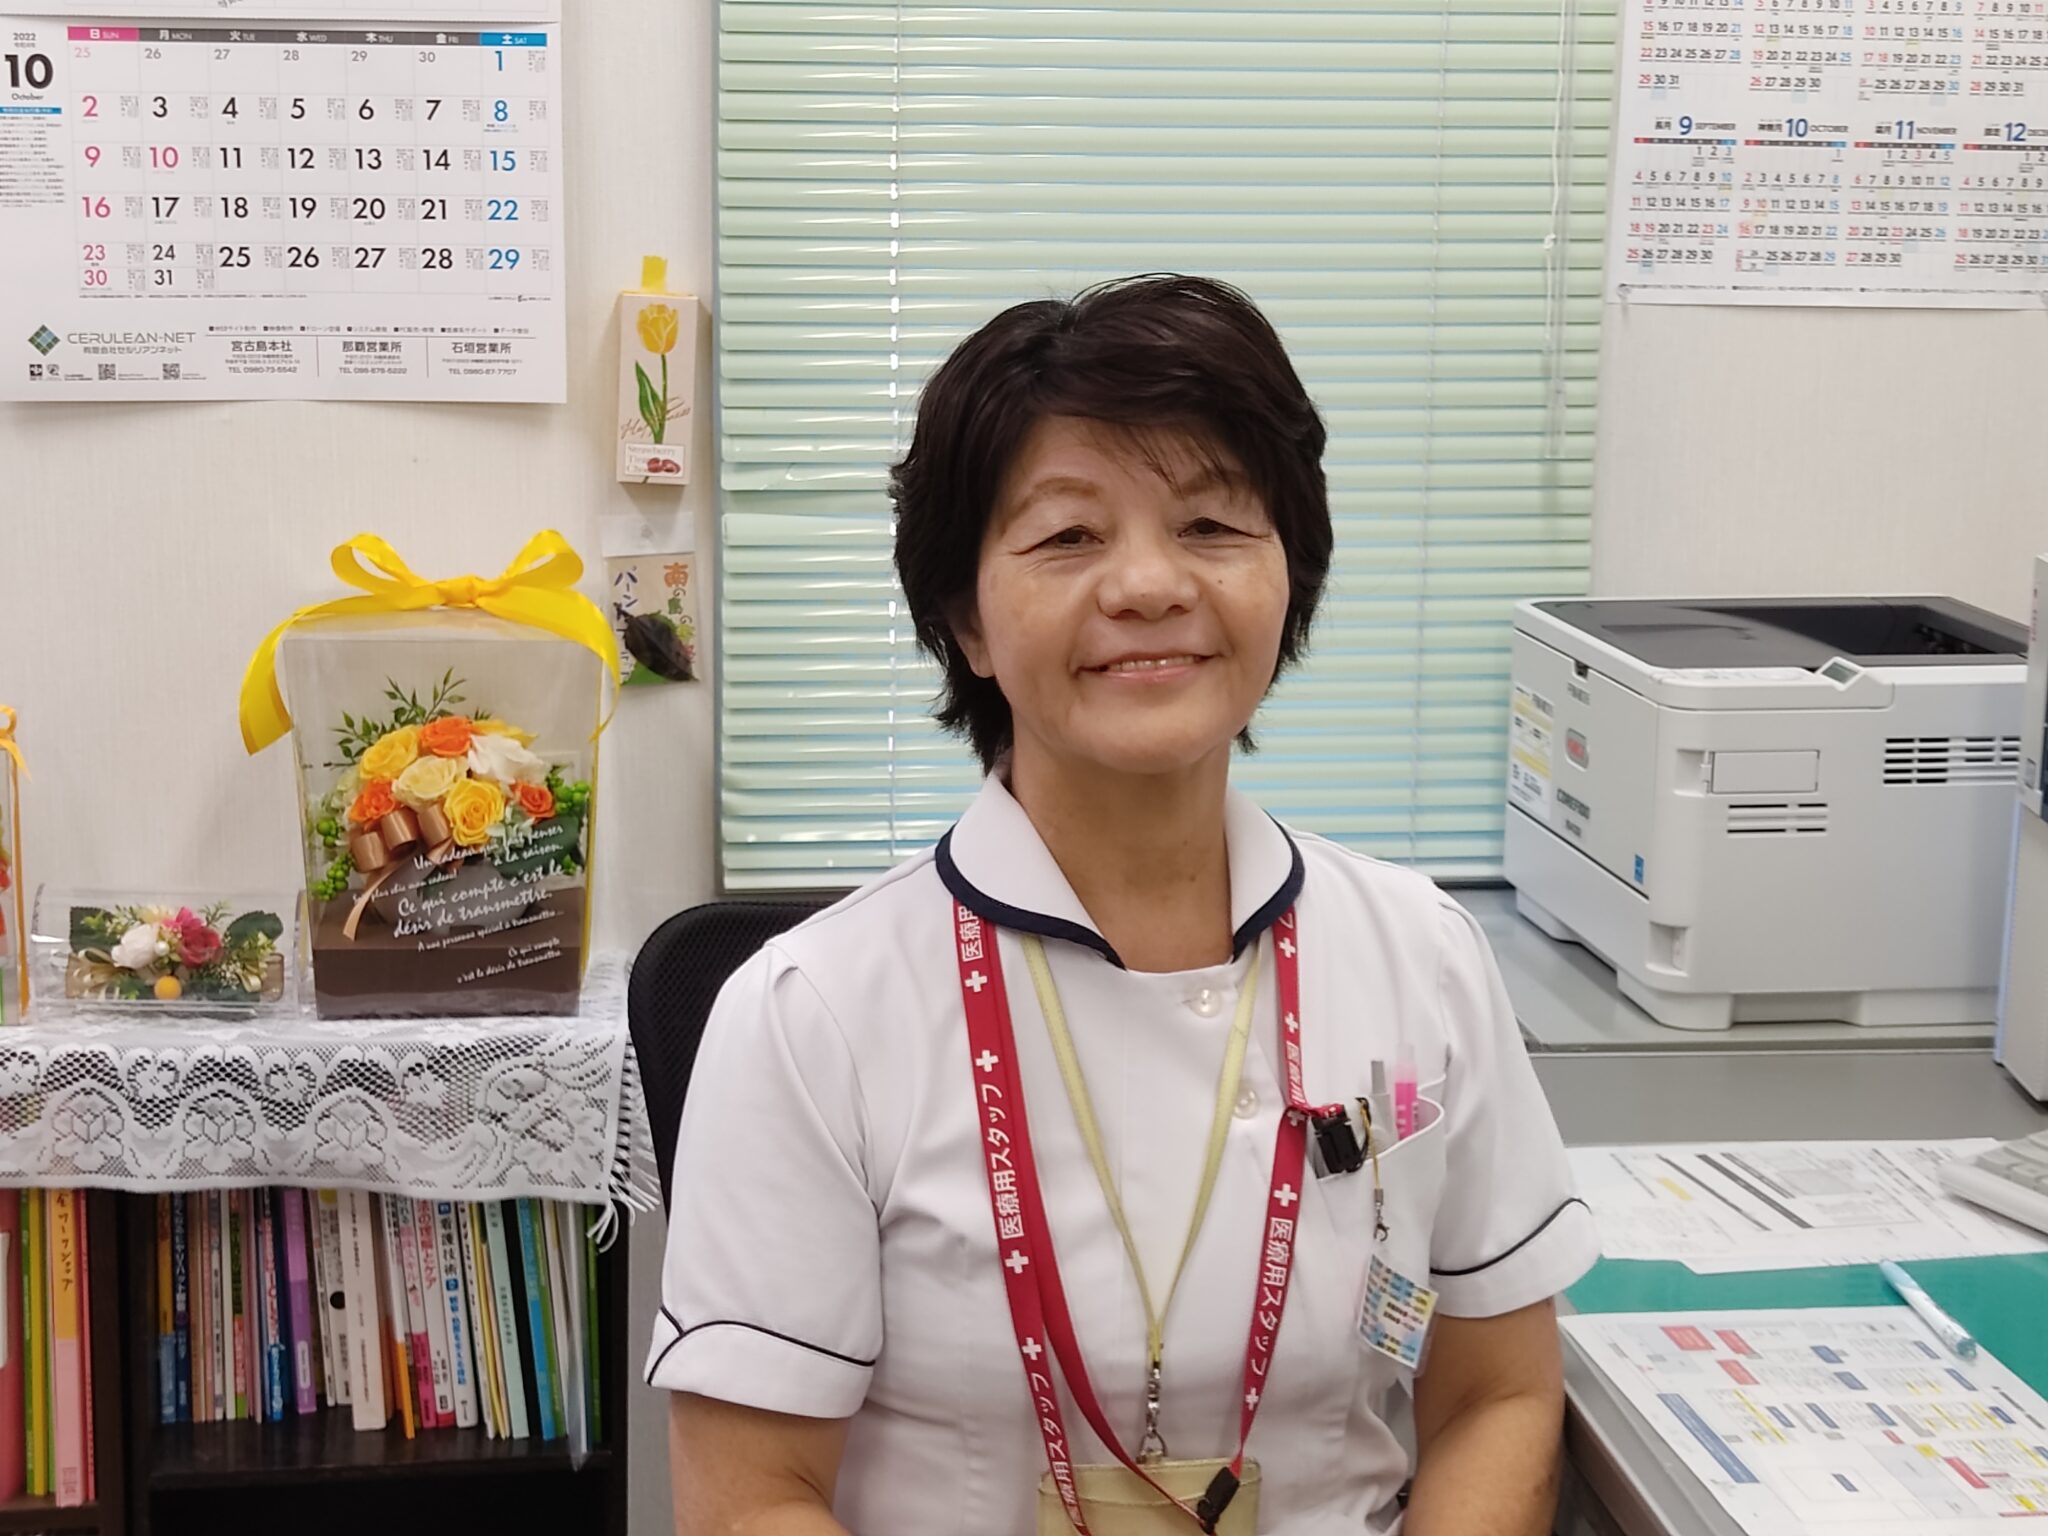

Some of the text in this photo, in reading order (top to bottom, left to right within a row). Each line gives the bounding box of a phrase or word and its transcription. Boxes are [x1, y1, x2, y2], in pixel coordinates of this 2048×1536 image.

[13, 33, 36, 41] 2022
[90, 29, 101, 39] 日
[159, 30, 169, 40] 月
[172, 32, 192, 40] MON
[229, 31, 241, 41] 火
[242, 33, 256, 41] TUE
[296, 32, 308, 42] 水
[309, 34, 327, 42] WED
[366, 33, 378, 43] 木
[378, 35, 394, 43] THU
[436, 33, 447, 44] 金
[448, 35, 459, 43] FRI
[502, 34, 513, 45] 土
[75, 47, 502, 71] 25 26 27 28 29 30 1
[4, 54, 53, 89] 10
[82, 96, 508, 121] 2 3 4 5 6 7 8
[1679, 116, 1692, 135] 9
[1786, 119, 1808, 137] 10
[1896, 120, 1914, 140] 11
[2005, 123, 2026, 141] 12
[85, 146, 515, 171] 9 10 11 12 13 14 15
[82, 197, 518, 220] 16 17 18 19 20 21 22
[83, 245, 519, 269] 23 24 25 26 27 28 29
[85, 270, 172, 285] 30 31
[67, 332, 196, 344] CERULEAN-NET
[231, 340, 293, 352] 宮古島本社
[342, 340, 402, 353] 那覇営業所
[452, 341, 512, 354] 石垣営業所
[228, 366, 242, 374] TEL
[413, 856, 433, 871] Un
[505, 847, 520, 863] la
[398, 859, 565, 917] Ce qui compte c'est le
[393, 918, 432, 939] désir
[437, 909, 455, 927] de
[981, 1083, 1024, 1239] 医療用スタッフ
[1251, 1216, 1294, 1376] 医療用スタッフ
